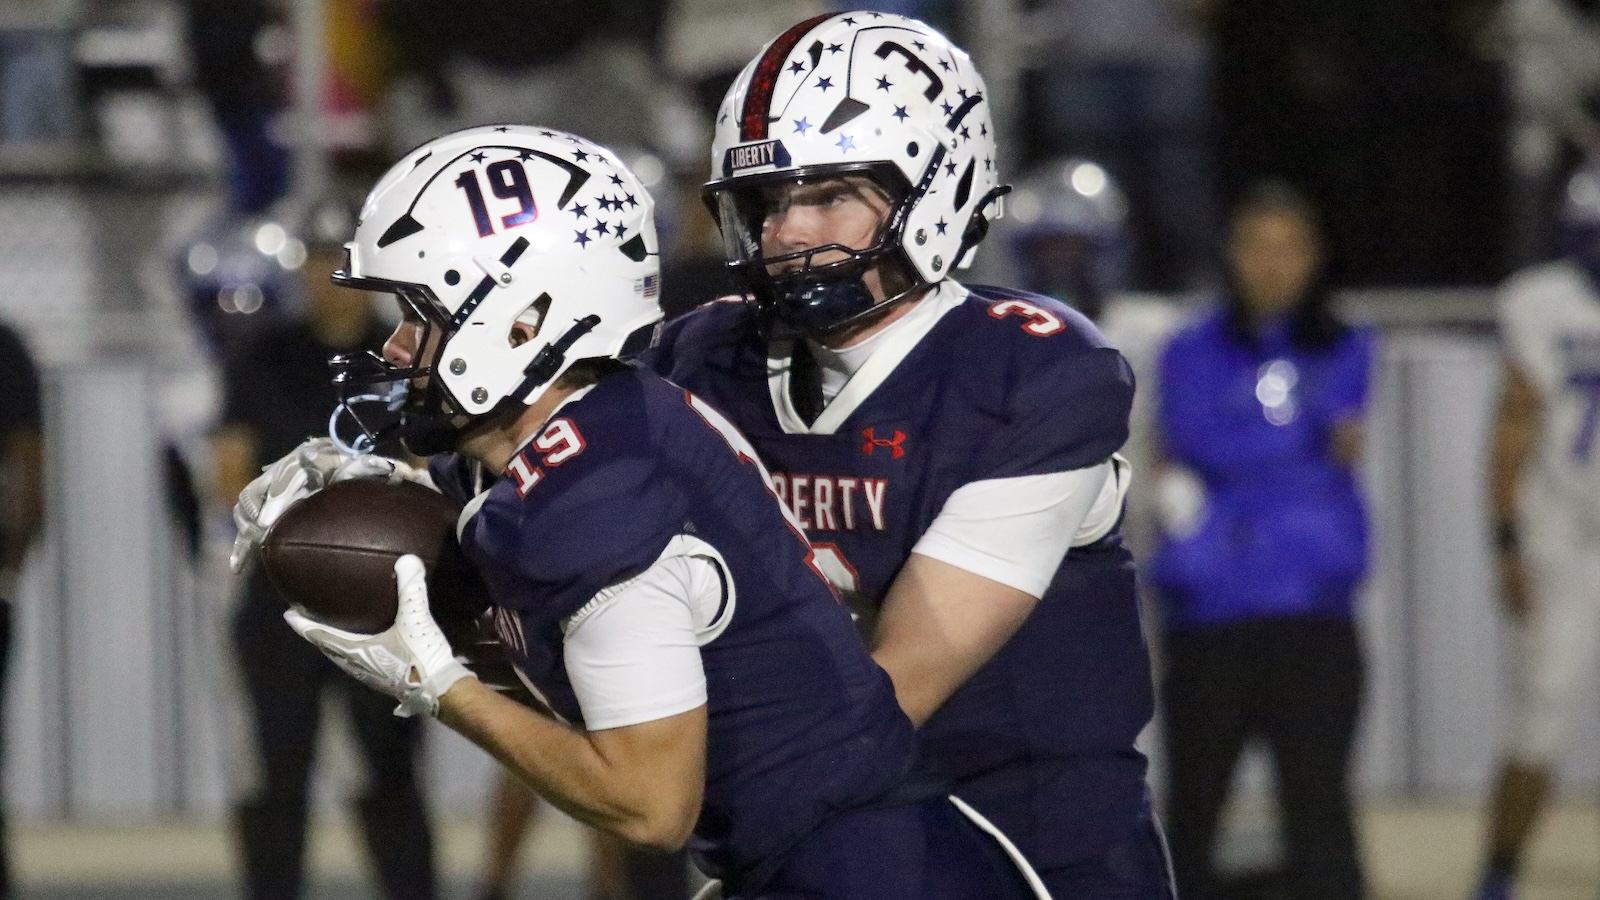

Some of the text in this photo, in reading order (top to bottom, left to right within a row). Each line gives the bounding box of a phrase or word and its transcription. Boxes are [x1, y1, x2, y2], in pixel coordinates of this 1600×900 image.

[874, 40, 944, 103] 3
[730, 142, 776, 169] LIBERTY
[455, 158, 539, 239] 19
[987, 299, 1067, 338] 3
[503, 415, 588, 500] 19
